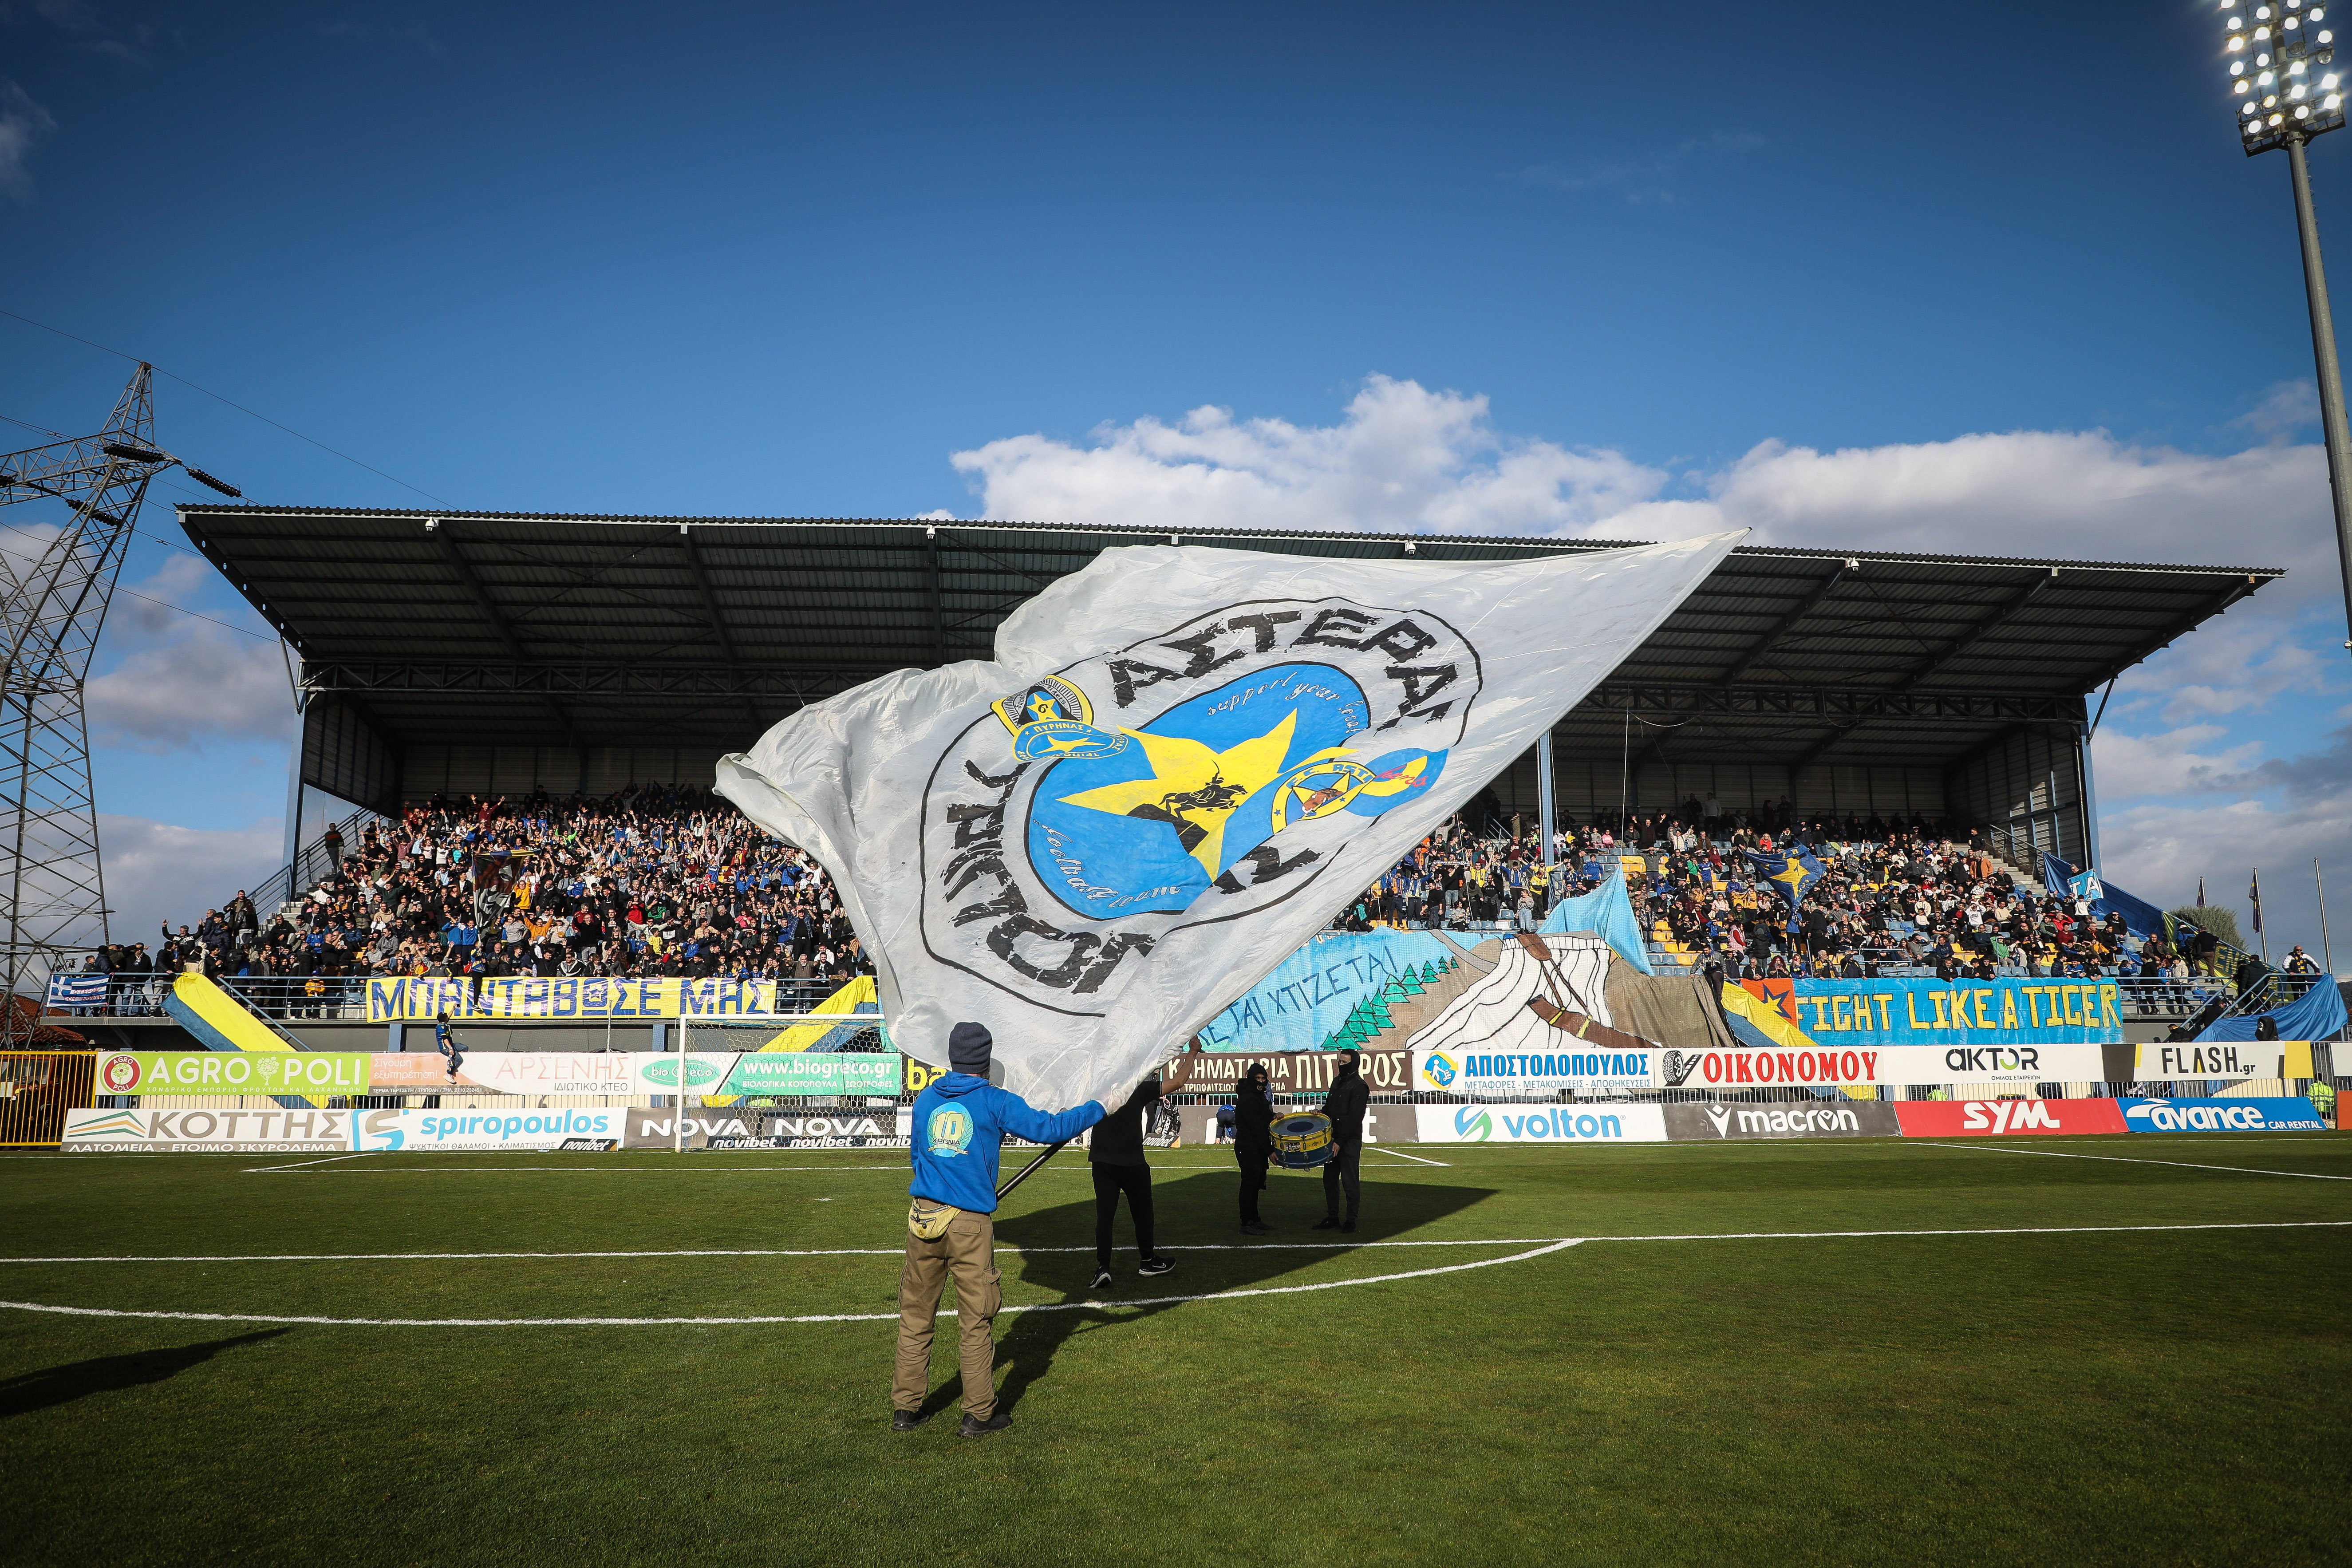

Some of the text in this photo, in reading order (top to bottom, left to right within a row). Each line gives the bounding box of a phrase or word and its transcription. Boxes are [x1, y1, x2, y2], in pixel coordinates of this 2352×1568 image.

[1107, 608, 1462, 737] ΑΣΤΕΡΑ
[1208, 671, 1298, 715] support
[1285, 683, 1340, 701] your
[1033, 722, 1084, 733] ΠΥΡΗΝΑΣ
[1267, 946, 1398, 1015] ΧΤΙΖΕΤΑΙ
[1907, 988, 1997, 1030] LIKE
[2003, 988, 2019, 1030] A
[2021, 984, 2121, 1027] TIGER
[113, 1056, 134, 1065] AGRO
[148, 1057, 360, 1085] AGRO POLI
[374, 1058, 411, 1069] Σίγουρη
[495, 1057, 629, 1080] ΑΡΣΕΝΗΣ
[743, 1059, 893, 1078] www.biogreco.gr
[1168, 1057, 1290, 1079] ΚΗΜΑΤΑΡΙΑ
[1295, 1052, 1407, 1089] ΠΙΤΡΟΣ
[1465, 1054, 1649, 1077] ΑΠΟΣΤΟΛΟΠΟΥΛΟΣ
[1703, 1051, 1878, 1083] ΟΙΚΟΝΟΜΟΥ
[374, 1070, 438, 1081] εξυπηρέτηση!
[554, 1082, 628, 1091] ΙΔΙΩΤΙΚΟ ΚΤΕΟ
[1465, 1079, 1651, 1089] ΜΕΤΑΦΟΡΕΣ ΜΕΤΑΚΟΜΙΣΕΙΣ ΑΠΟΘΗΚΕΥΣΕΙΣ
[1184, 1083, 1238, 1092] ΤΡΙΠΟΛΙΤΣΙΩΤ
[148, 1112, 346, 1138] ΚΟΤΤΗΣ
[420, 1109, 608, 1141] spiropoulos
[641, 1118, 750, 1137] NOVA
[773, 1118, 883, 1136] NOVA
[934, 1112, 964, 1139] 10
[1502, 1108, 1622, 1138] volton
[1737, 1109, 1859, 1133] macron
[1964, 1101, 2060, 1134] SYM
[2151, 1106, 2322, 1130] avance CAR RENTAL
[67, 1143, 337, 1152] ΛΑΤΟΜΕΙΑ ΕΤΟΙΜΟ ΣΚΥΡΟΔΕΜΑ
[562, 1139, 610, 1151] novibet
[713, 1136, 911, 1148] novibet novibet novib
[1142, 1134, 1175, 1147] novibet
